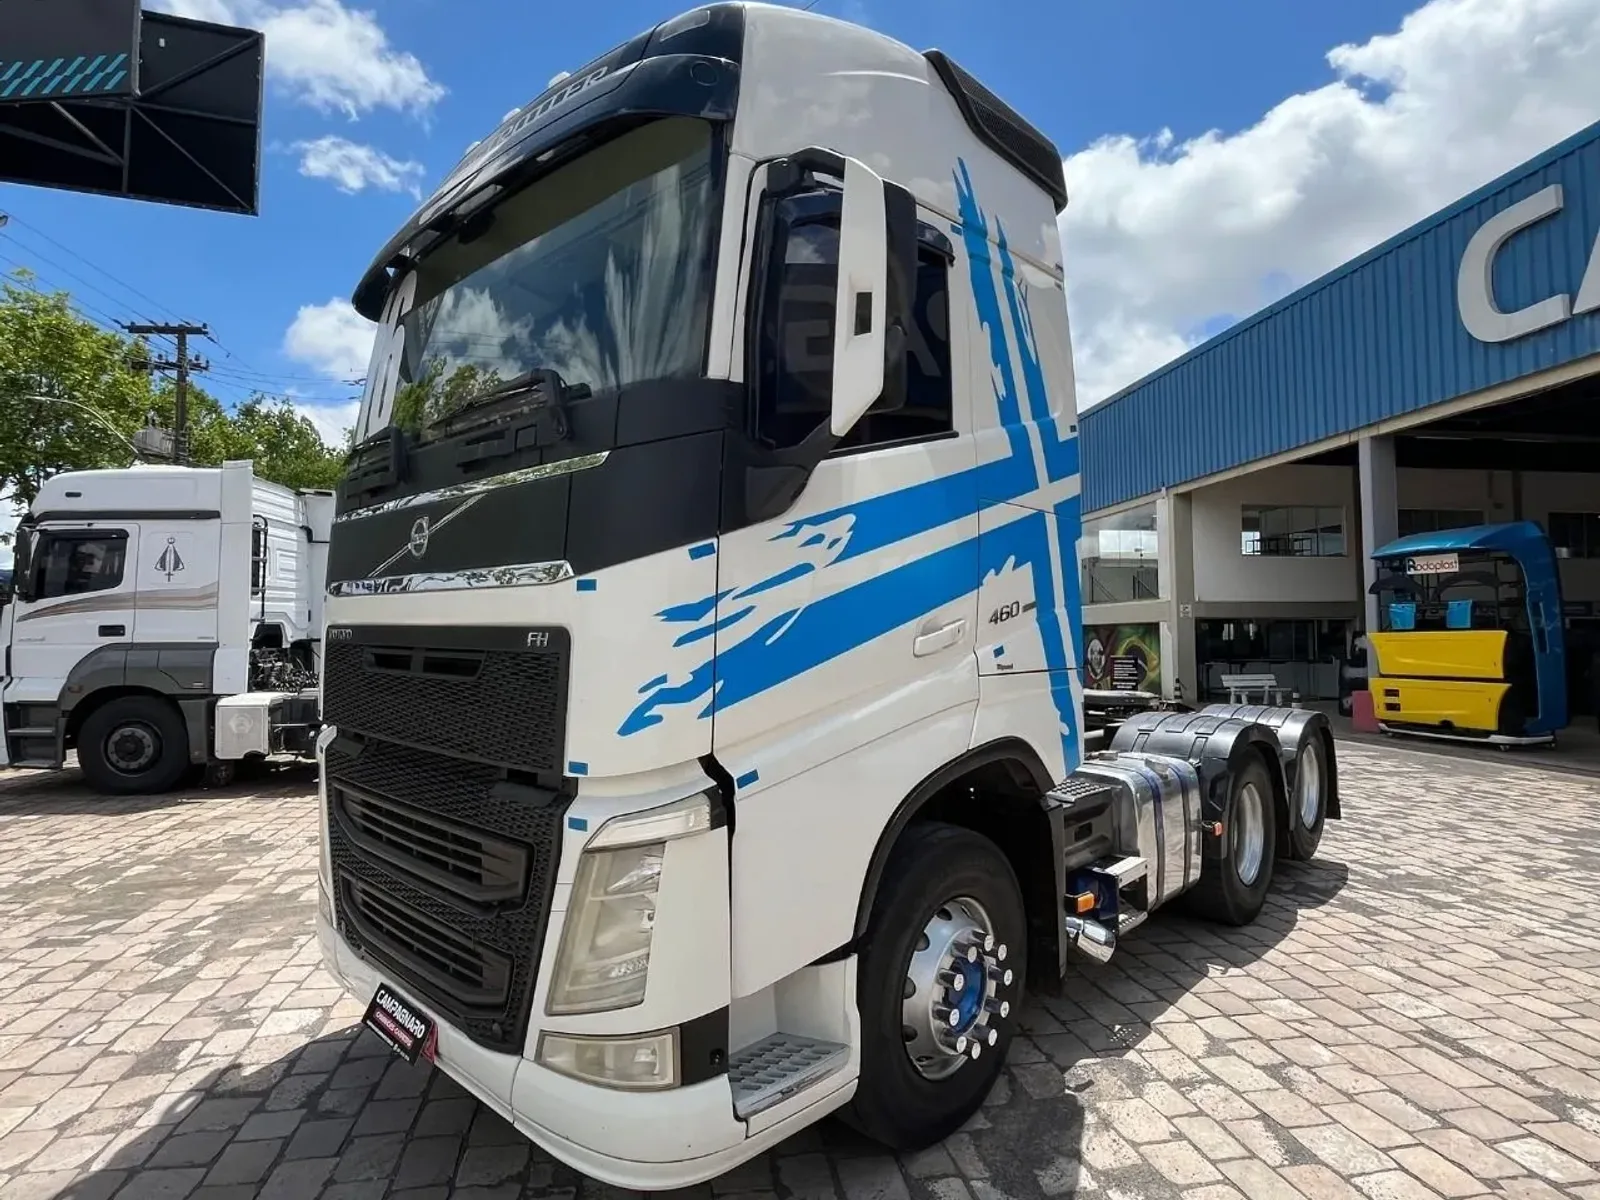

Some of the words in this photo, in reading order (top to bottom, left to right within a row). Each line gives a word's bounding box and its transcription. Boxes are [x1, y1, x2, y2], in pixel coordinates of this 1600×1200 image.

[1457, 183, 1600, 342] C
[1407, 557, 1458, 573] Rodoplast
[988, 600, 1020, 625] 460
[527, 631, 549, 647] FH
[376, 989, 426, 1039] CAMPAGNARO
